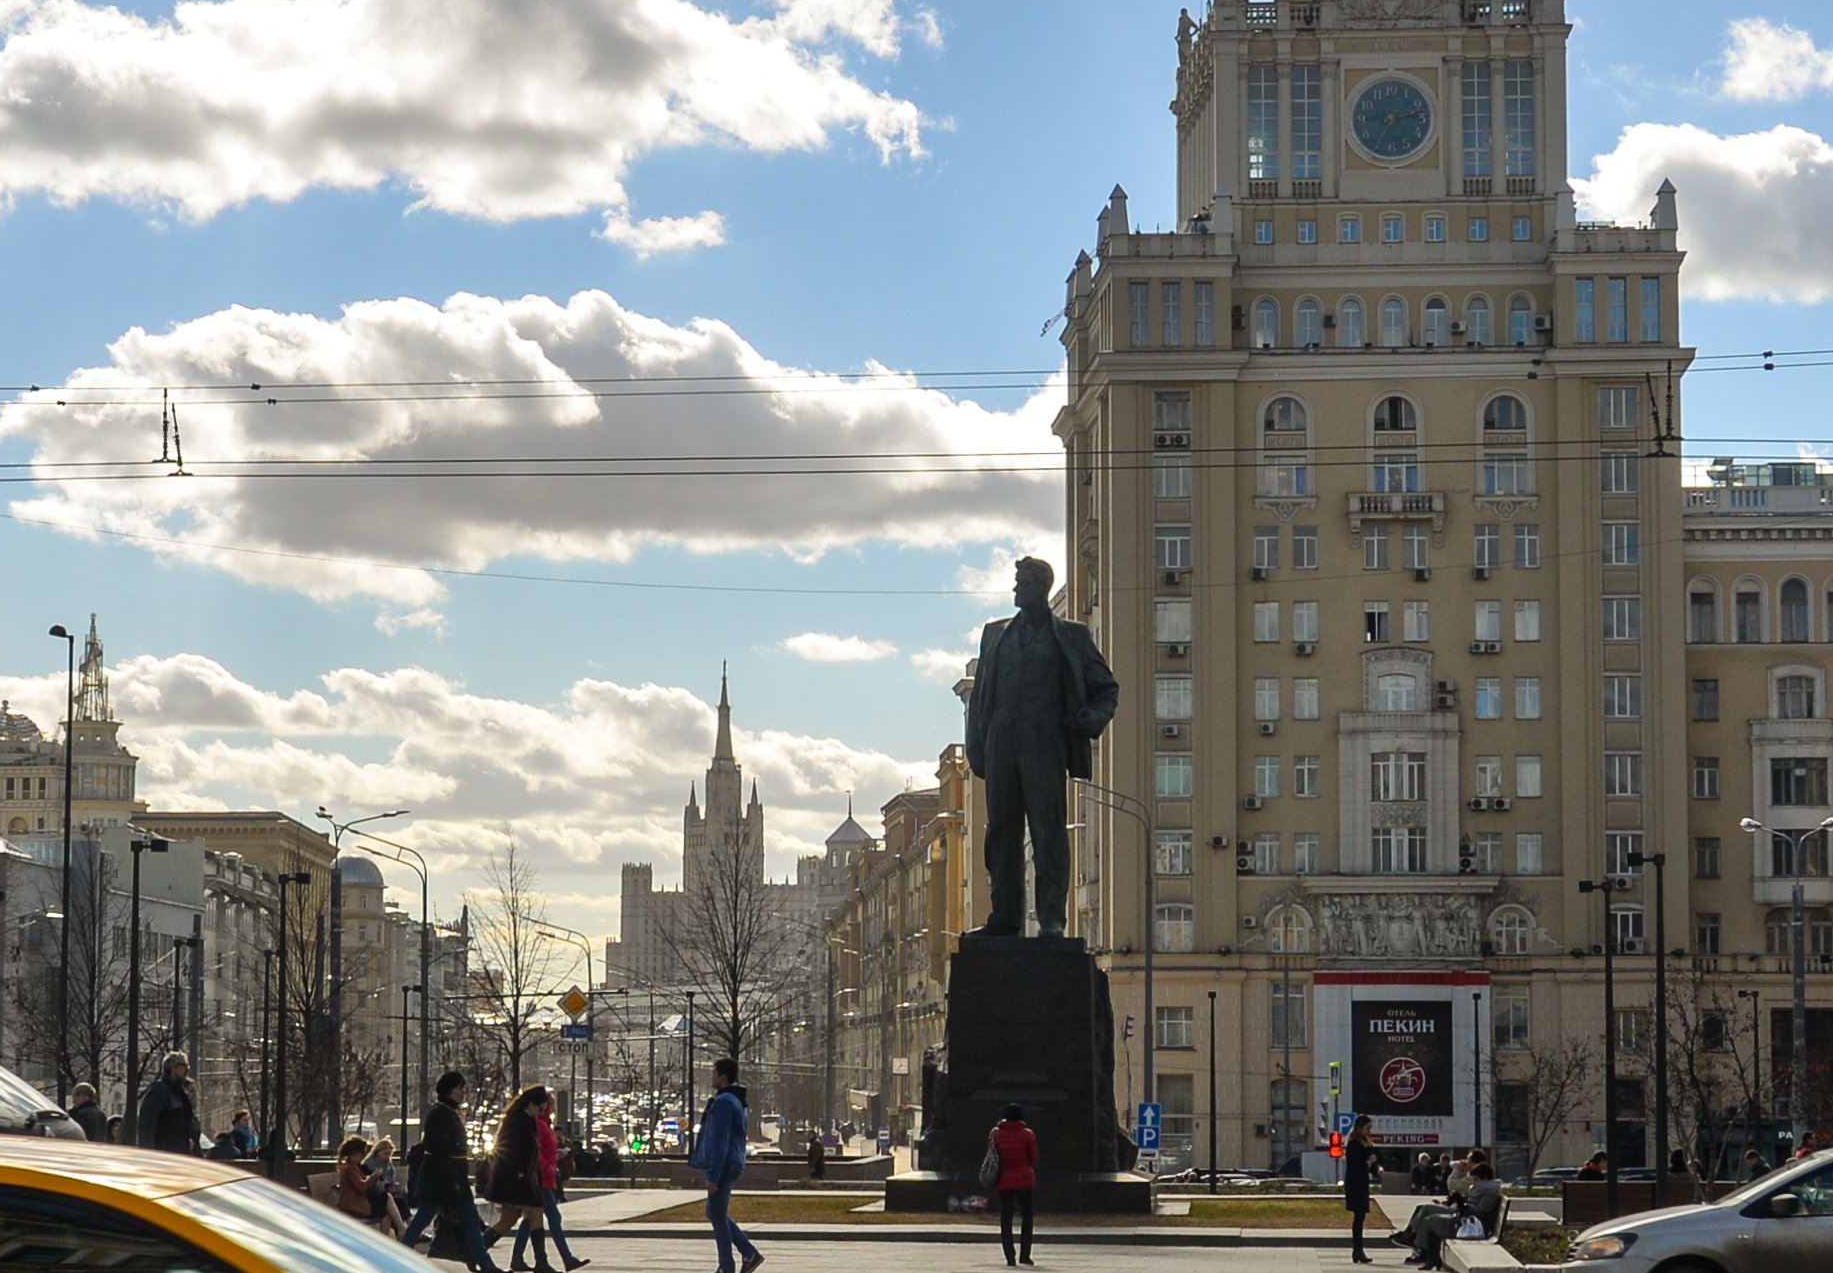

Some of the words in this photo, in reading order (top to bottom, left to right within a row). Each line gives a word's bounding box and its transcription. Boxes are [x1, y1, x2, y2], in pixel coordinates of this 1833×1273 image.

[1387, 1009, 1417, 1017] ОТЕЛЬ
[1369, 1019, 1435, 1033] ПЕКИН
[1388, 1035, 1416, 1043] HOTEL
[558, 1042, 589, 1054] СТОП
[1382, 1134, 1425, 1144] PEKING
